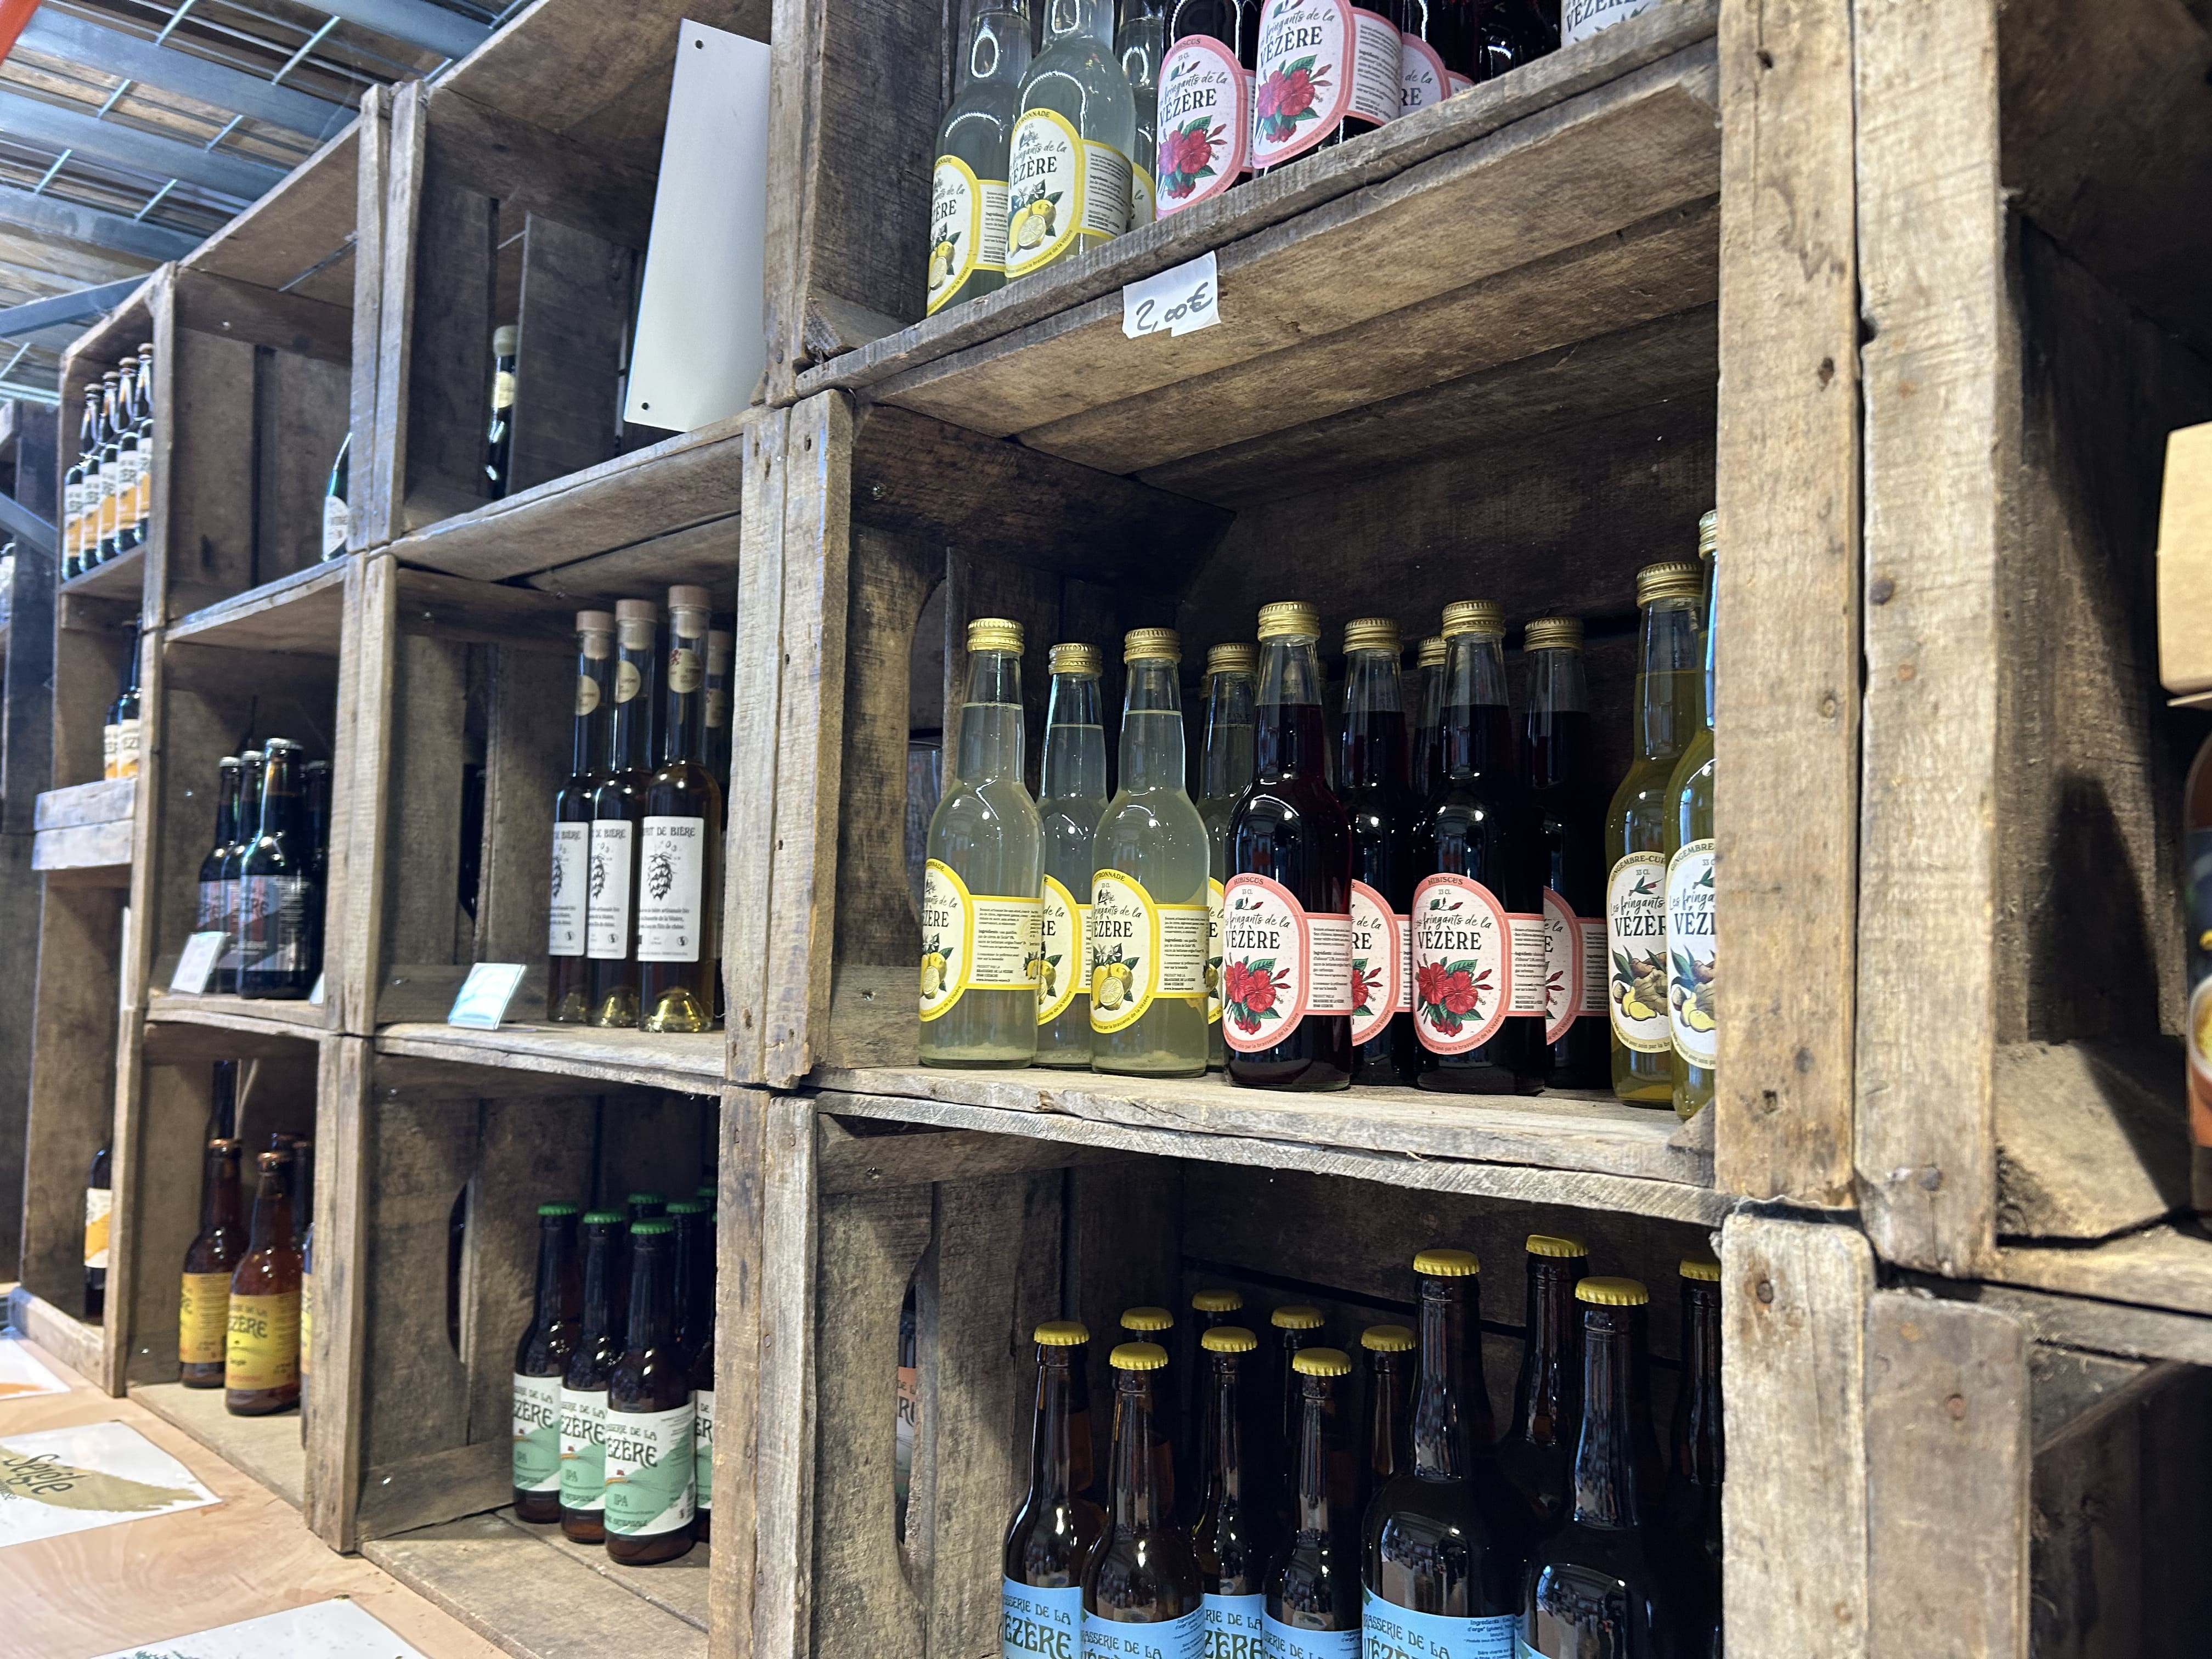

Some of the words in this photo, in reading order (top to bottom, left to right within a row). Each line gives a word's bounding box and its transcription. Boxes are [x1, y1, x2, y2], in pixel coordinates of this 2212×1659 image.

[1306, 8, 1321, 20] de
[1322, 9, 1335, 22] la
[1261, 25, 1323, 67] VÉZÈRE
[1201, 71, 1214, 83] de
[1217, 72, 1228, 84] la
[1405, 70, 1419, 82] de
[1420, 71, 1432, 84] la
[1160, 88, 1217, 127] VÉZÈRE
[1043, 140, 1055, 151] de
[1057, 141, 1068, 153] la
[935, 199, 957, 221] ÈRE
[1136, 281, 1213, 332] 2,00€
[657, 827, 667, 836] DE
[1234, 877, 1264, 885] HIBISCUS
[1427, 877, 1463, 885] HIBISCUS
[939, 895, 947, 906] de
[949, 898, 957, 909] la
[1621, 895, 1666, 915] fringants
[1682, 888, 1715, 911] fringa
[923, 905, 949, 927] ZÈRE
[1043, 905, 1053, 916] de
[1056, 907, 1065, 917] la
[1120, 905, 1130, 916] de
[1132, 907, 1142, 918] la
[1230, 911, 1263, 929] fringants
[1265, 914, 1277, 926] de
[1279, 916, 1290, 928] la
[1092, 916, 1133, 938] ÉZÈRE
[1357, 915, 1369, 927] de
[1371, 918, 1382, 929] la
[1423, 912, 1463, 930] fringants
[1465, 914, 1478, 926] de
[1481, 917, 1492, 929] la
[1552, 921, 1563, 933] la
[1226, 924, 1280, 949] VÉZÈRE
[1418, 926, 1482, 950] VÉZÈRE
[644, 1430, 657, 1441] LA
[3, 1454, 89, 1495] Seigle
[614, 1494, 628, 1506] IPA
[1035, 1604, 1049, 1618] DE
[1054, 1610, 1071, 1626] LA
[1227, 1612, 1243, 1626] DE
[1248, 1616, 1262, 1631] LA
[1005, 1611, 1072, 1659] ÉZÈRE
[1124, 1640, 1139, 1655] DE
[1145, 1645, 1162, 1659] LA
[1290, 1643, 1304, 1658] DE
[1408, 1630, 1424, 1650] DE
[1430, 1641, 1450, 1659] LA
